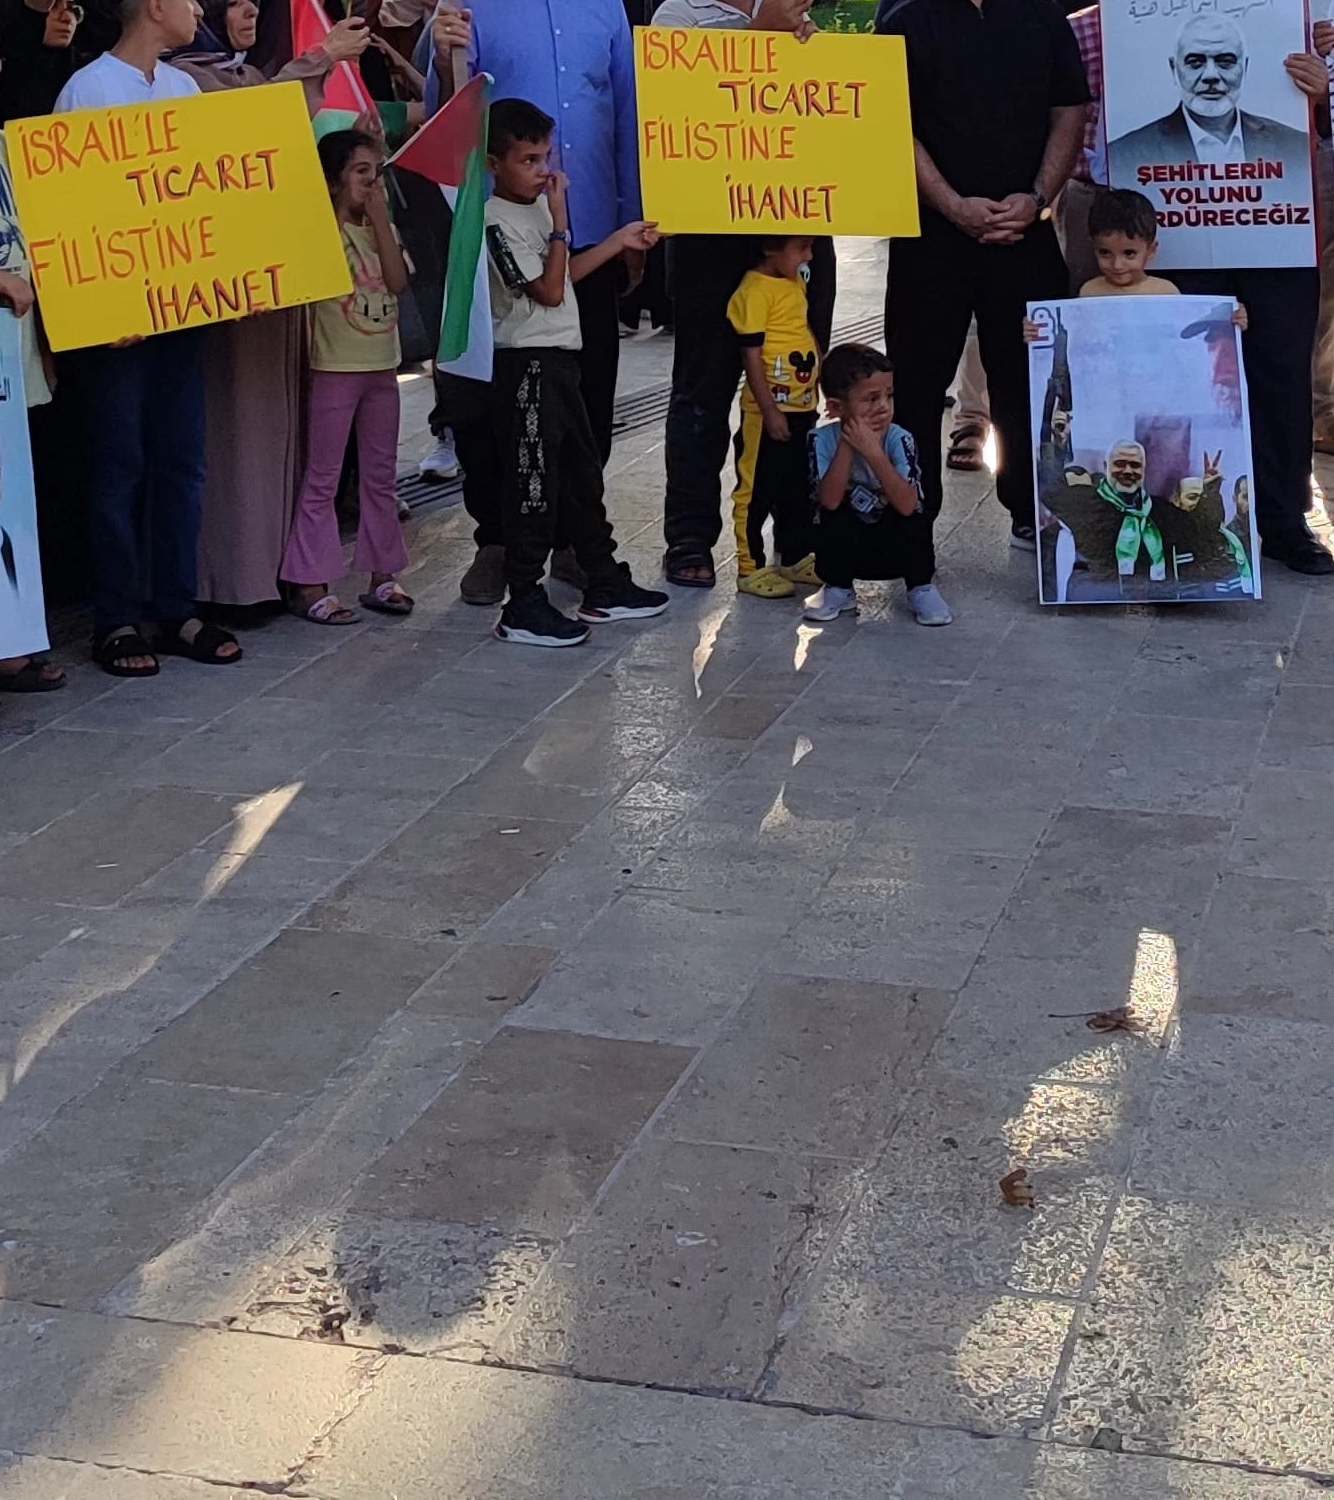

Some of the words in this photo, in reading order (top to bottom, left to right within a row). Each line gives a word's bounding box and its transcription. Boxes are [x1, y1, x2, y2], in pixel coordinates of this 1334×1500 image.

[717, 75, 868, 119] TİCARET
[125, 147, 281, 207] TİCARET
[1136, 158, 1284, 186] ŞEHİTLERİN
[724, 173, 838, 224] İHANET
[1158, 185, 1264, 205] YOLUNU
